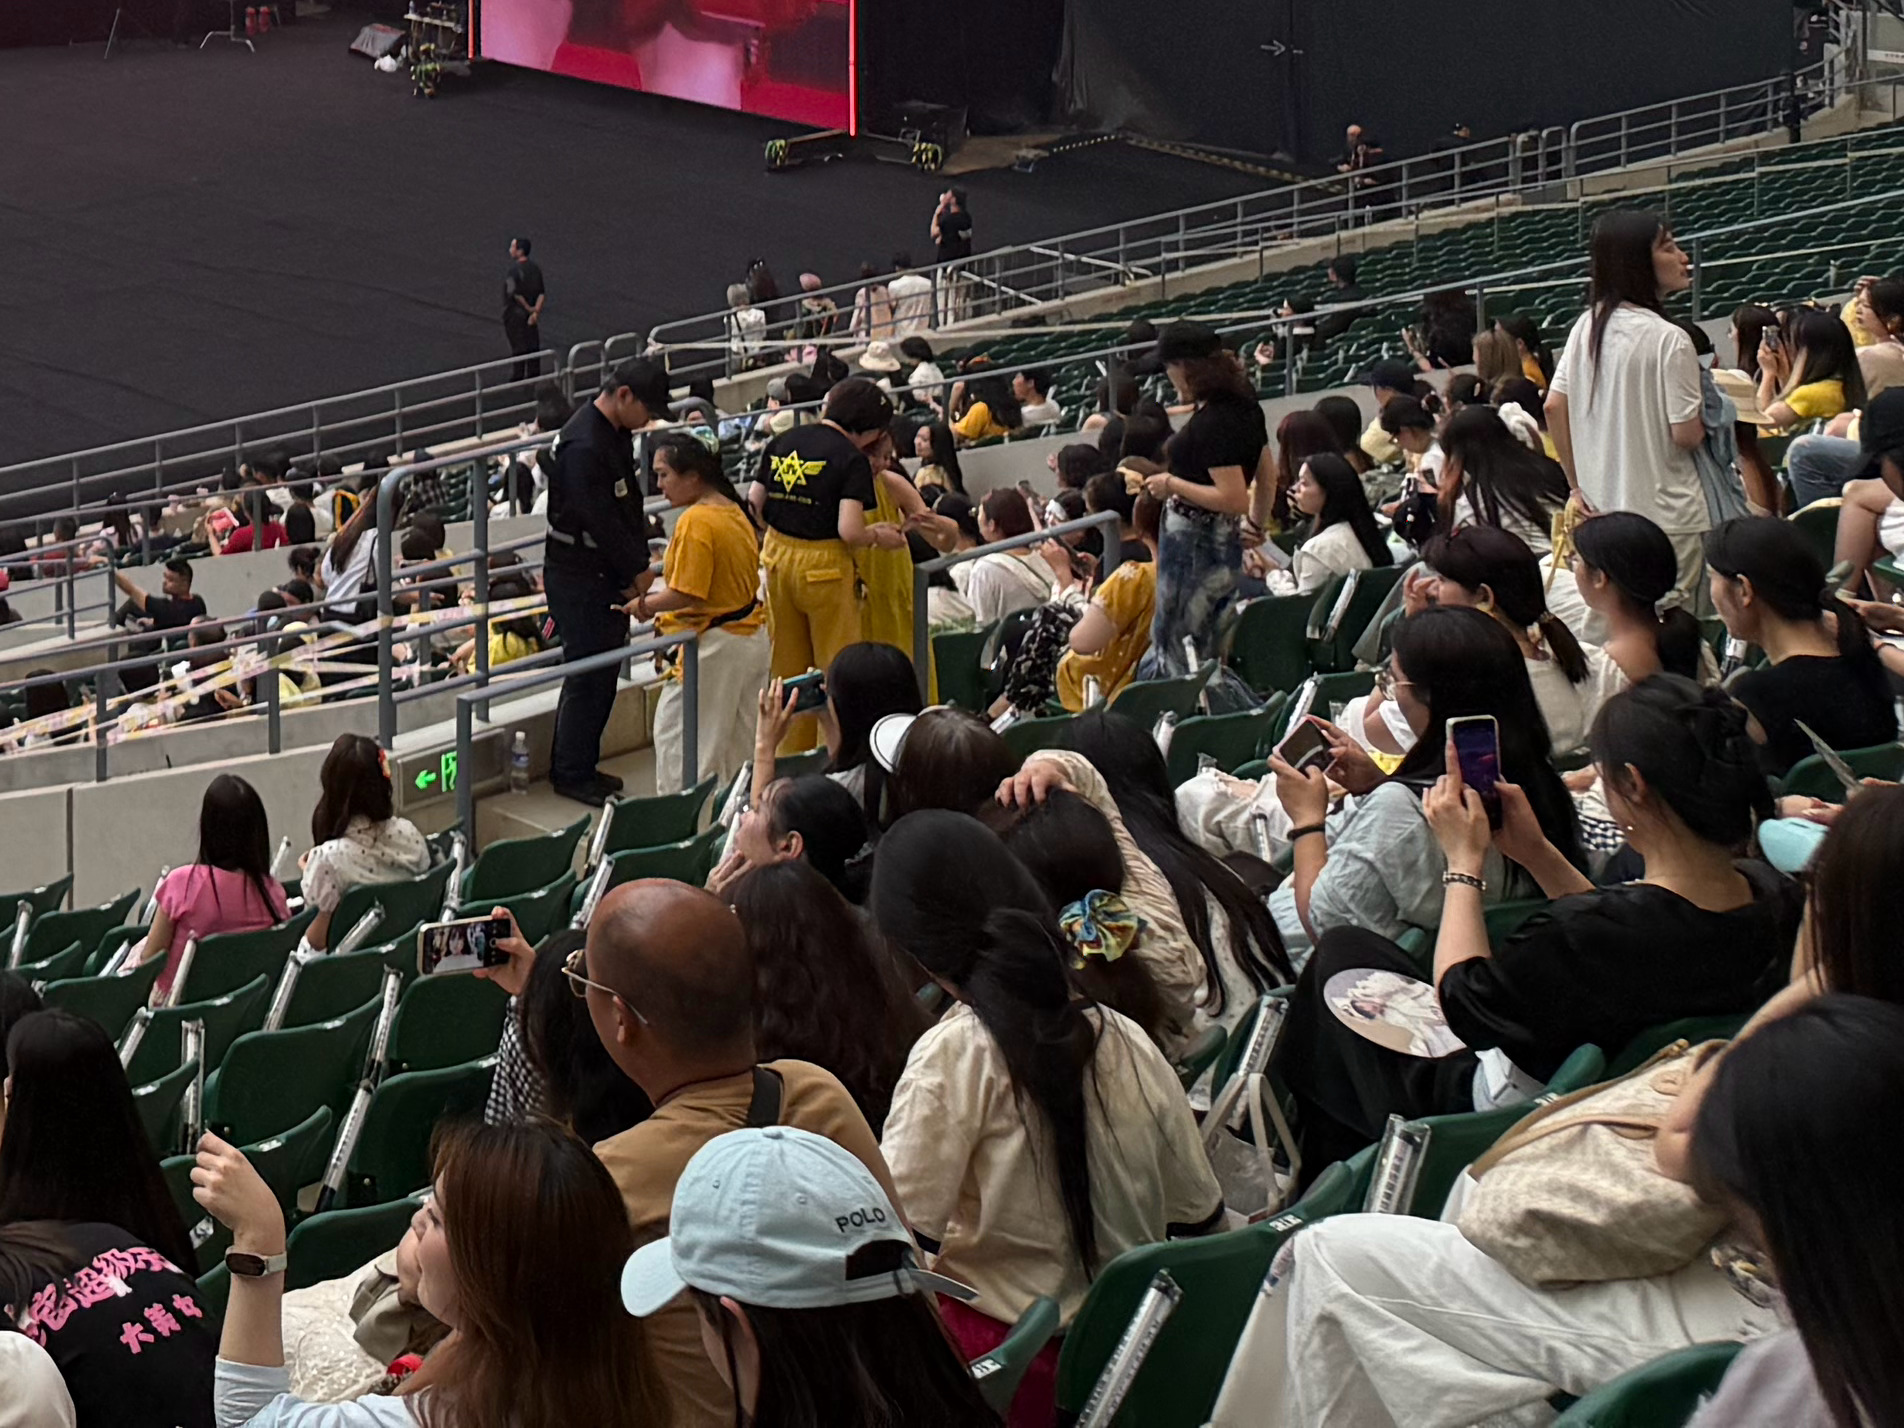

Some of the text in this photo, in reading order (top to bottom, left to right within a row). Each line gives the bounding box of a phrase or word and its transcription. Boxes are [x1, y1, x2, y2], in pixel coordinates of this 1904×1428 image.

[835, 1207, 886, 1233] POLO
[119, 1293, 204, 1355] 大美女
